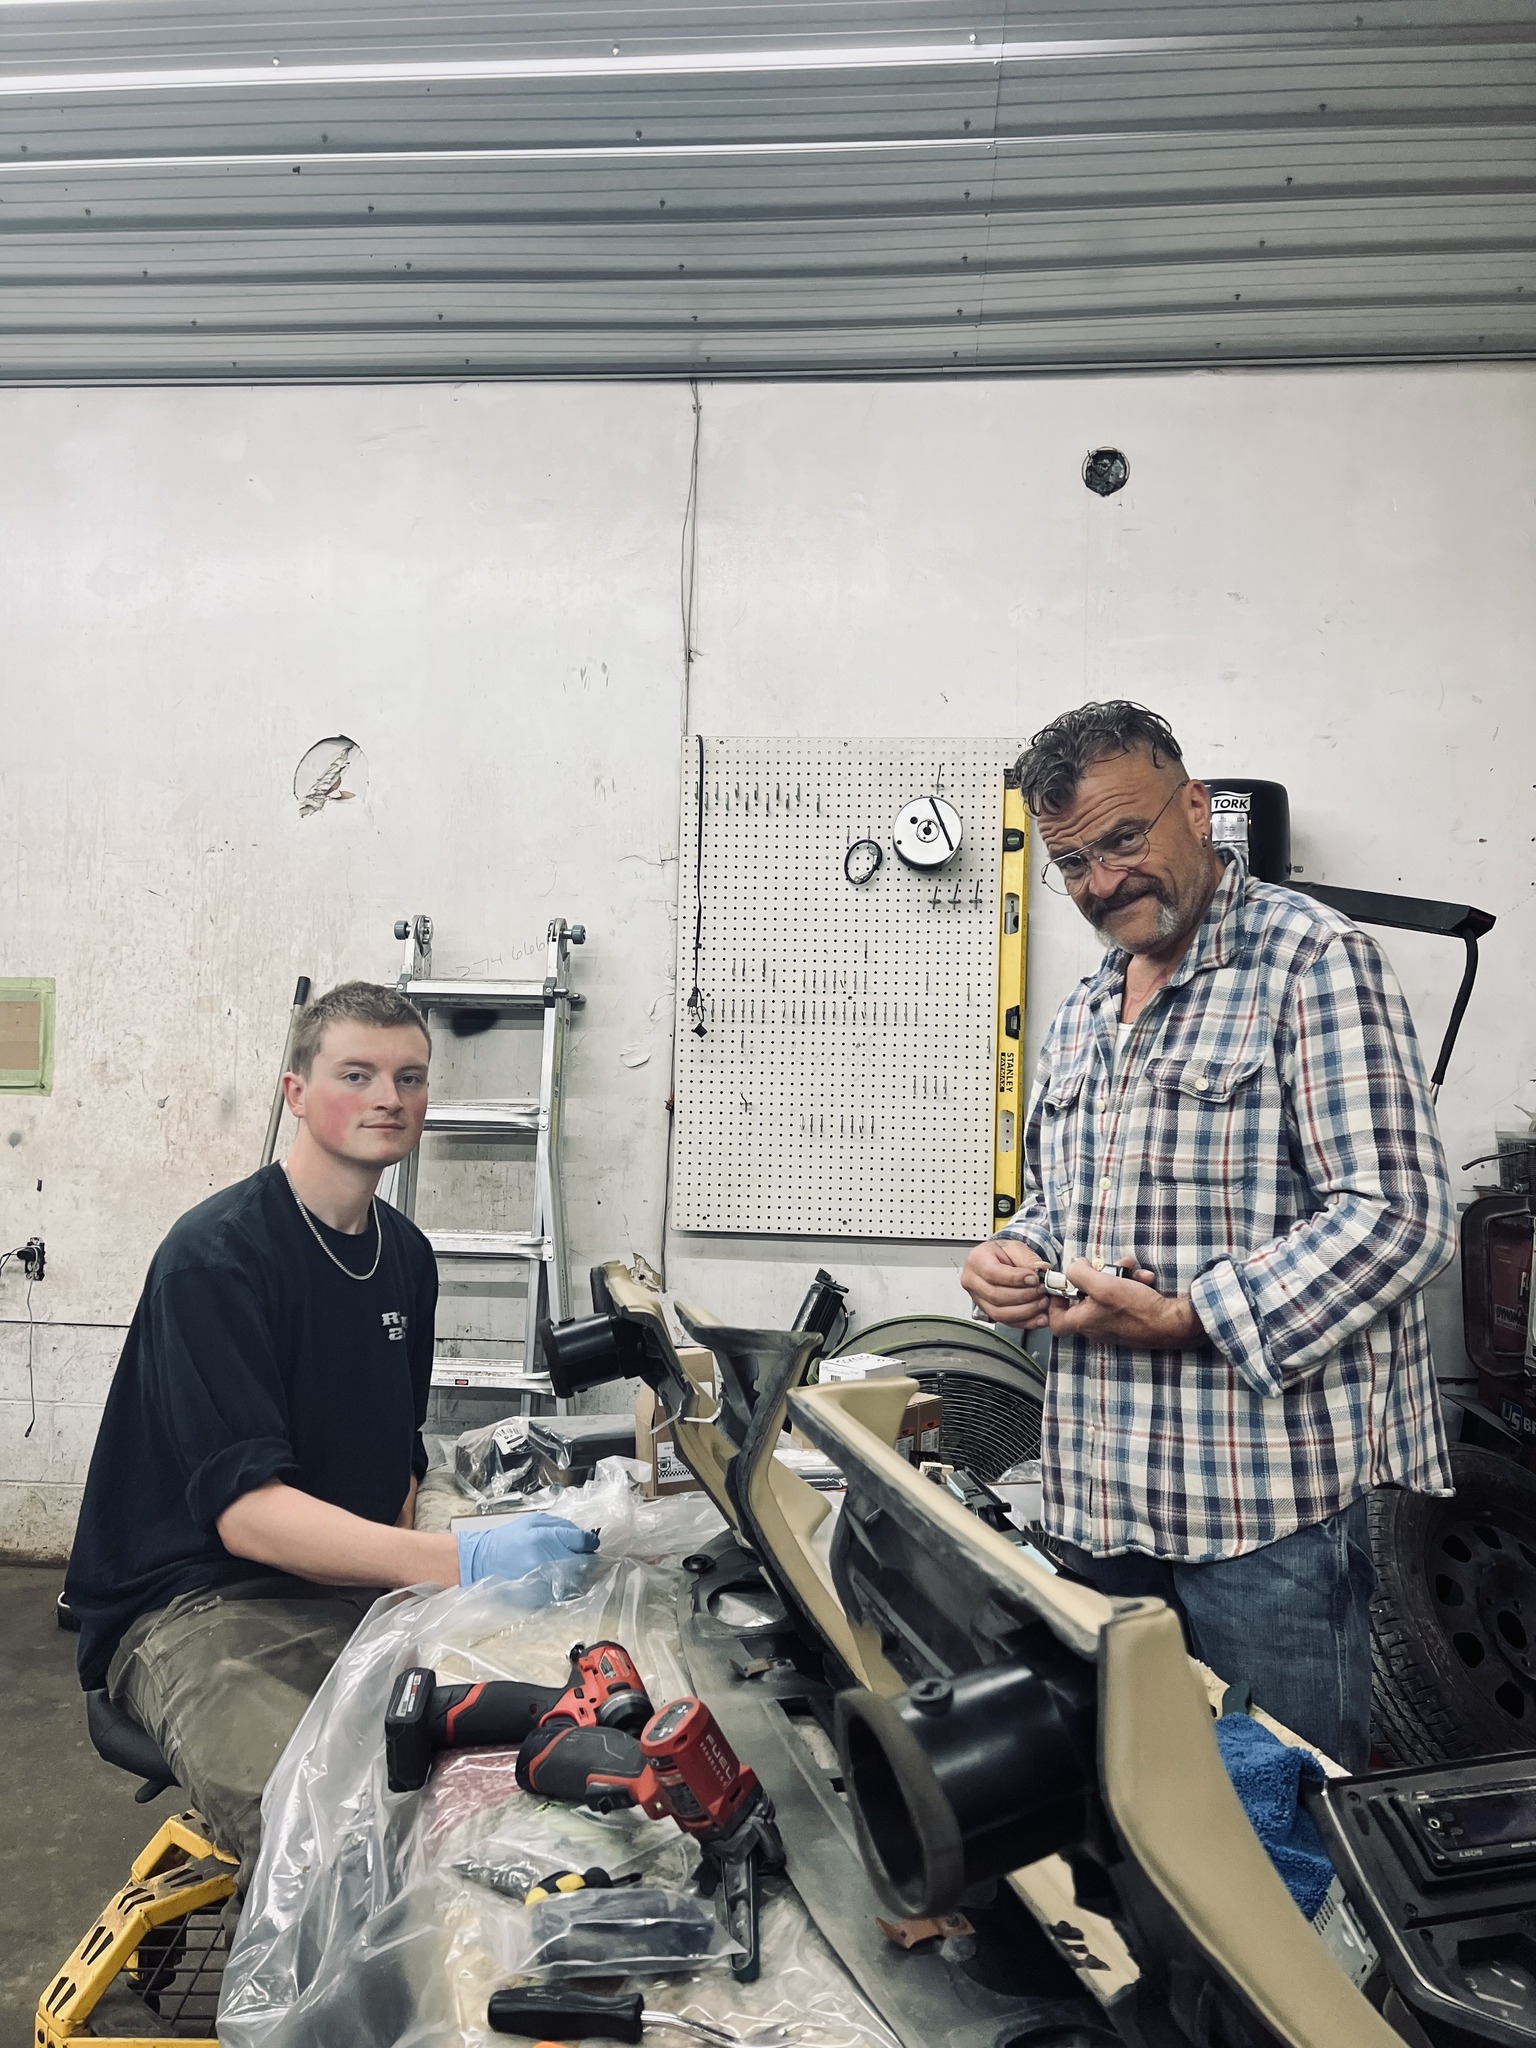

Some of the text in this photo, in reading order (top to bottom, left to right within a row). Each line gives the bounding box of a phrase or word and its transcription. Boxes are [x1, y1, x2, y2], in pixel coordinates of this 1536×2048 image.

[1213, 798, 1249, 810] TORK
[511, 935, 546, 961] 666
[1005, 1052, 1015, 1093] STANLEY
[704, 1734, 732, 1780] FUEL
